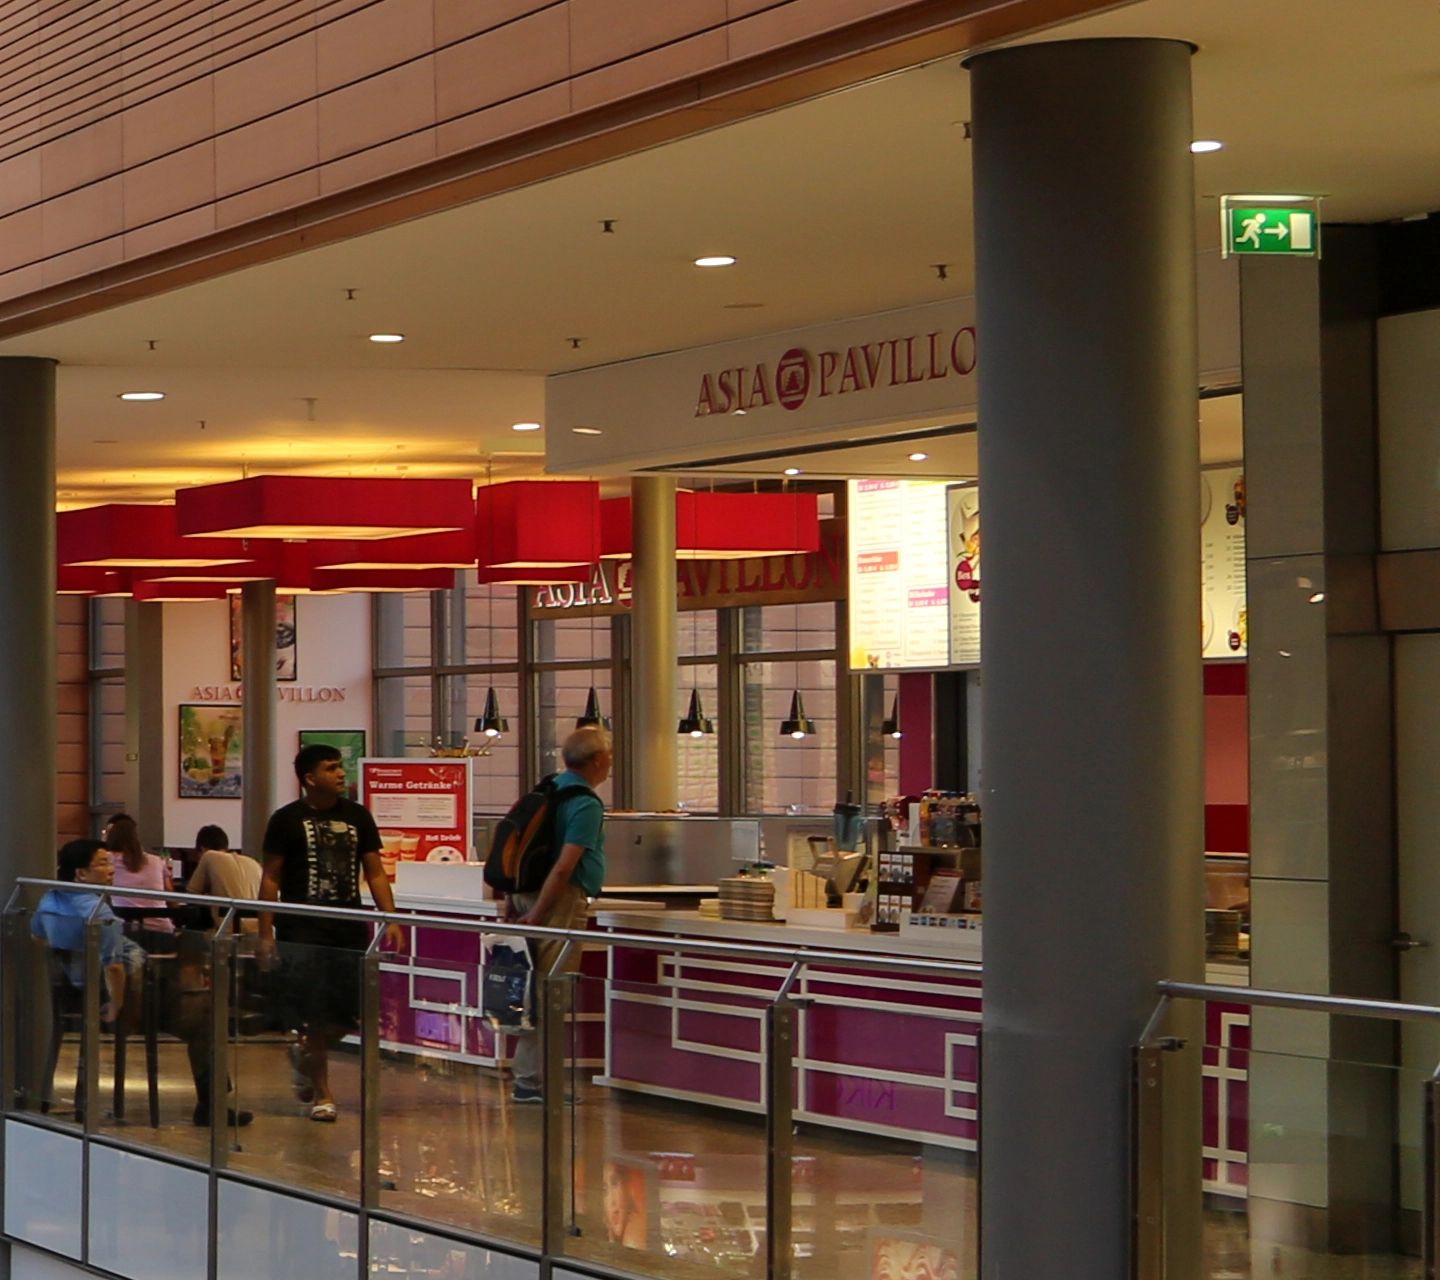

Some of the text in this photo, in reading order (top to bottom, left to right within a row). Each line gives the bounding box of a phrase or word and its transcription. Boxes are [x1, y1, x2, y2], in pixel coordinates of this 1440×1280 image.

[695, 326, 977, 418] ASIA PAVILLO
[677, 534, 844, 598] AVILLON
[193, 686, 347, 702] ASIA VILLON
[369, 780, 404, 789] Warme
